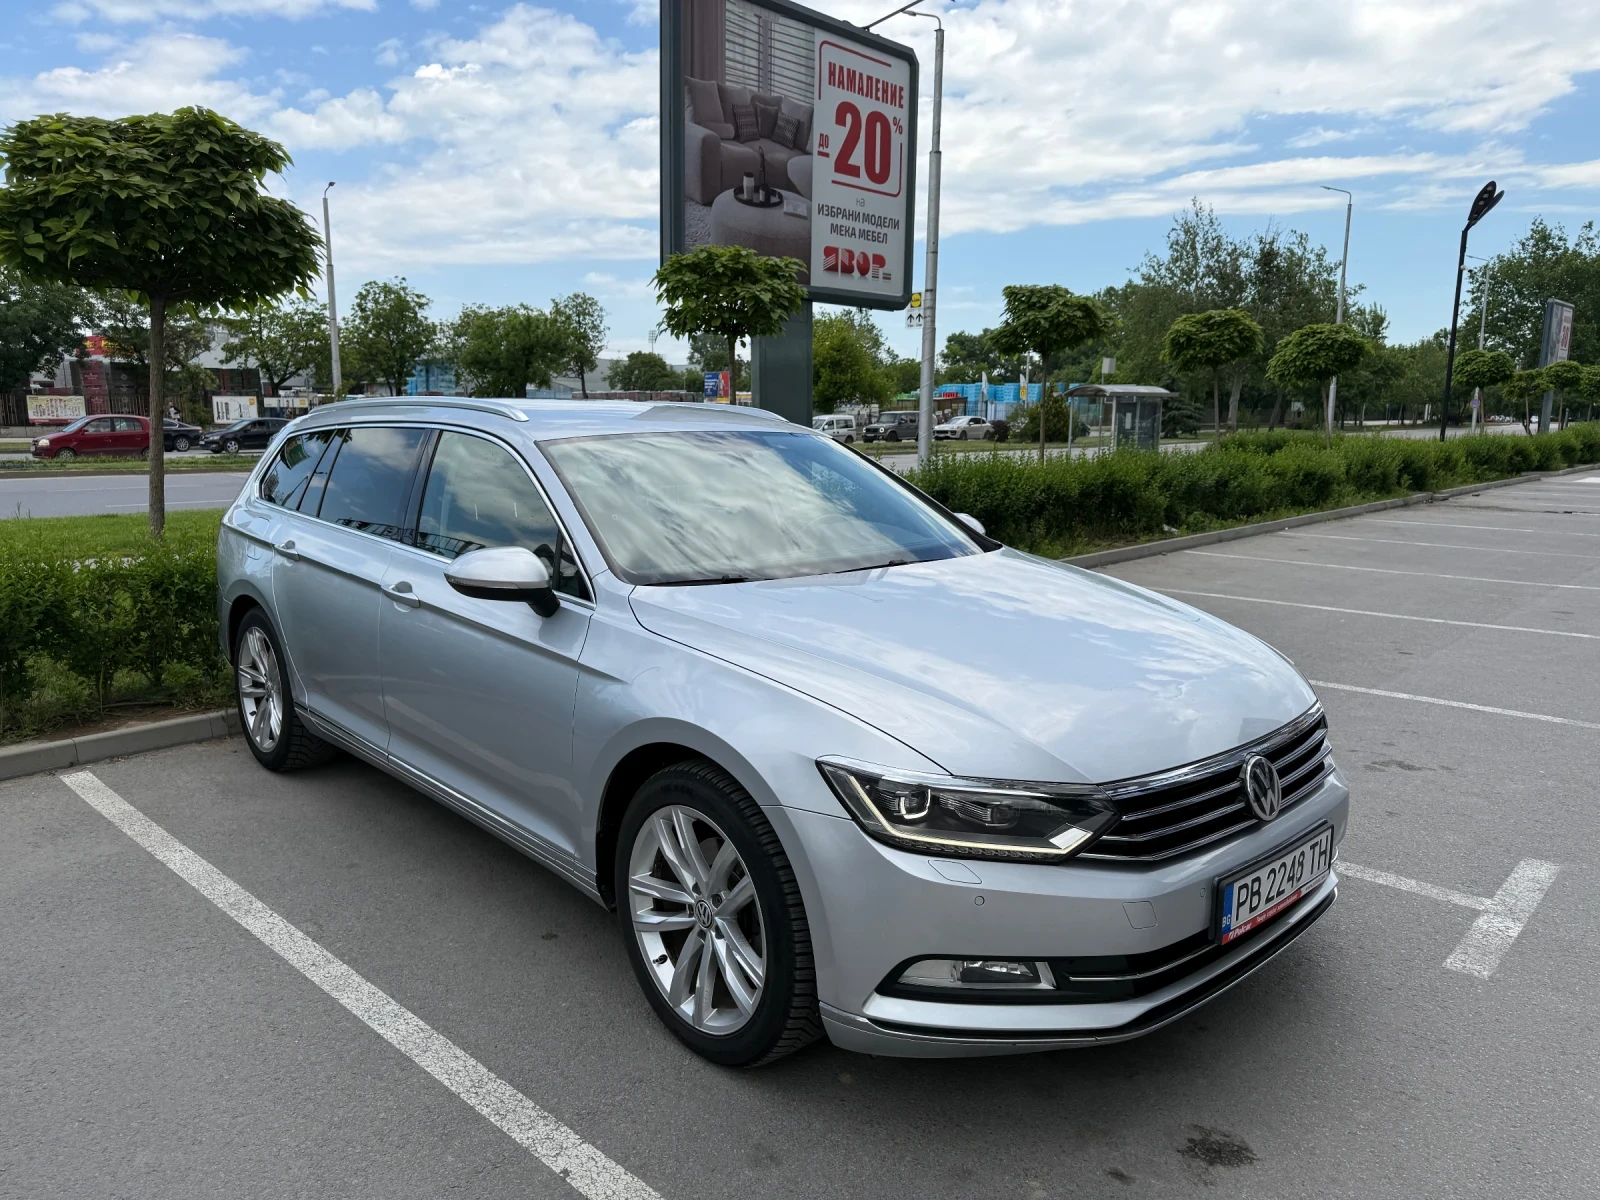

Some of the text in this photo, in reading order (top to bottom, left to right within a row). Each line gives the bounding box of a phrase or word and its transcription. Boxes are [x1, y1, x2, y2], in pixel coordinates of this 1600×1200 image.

[828, 61, 904, 109] НАМАЛЕНИЕ
[817, 203, 900, 231] ИЗБРАНИ МОДЕЛИ
[830, 222, 888, 245] МЕКА МЕБЕЛ
[1235, 834, 1329, 921] PB 2248 TH
[1222, 914, 1231, 928] BG
